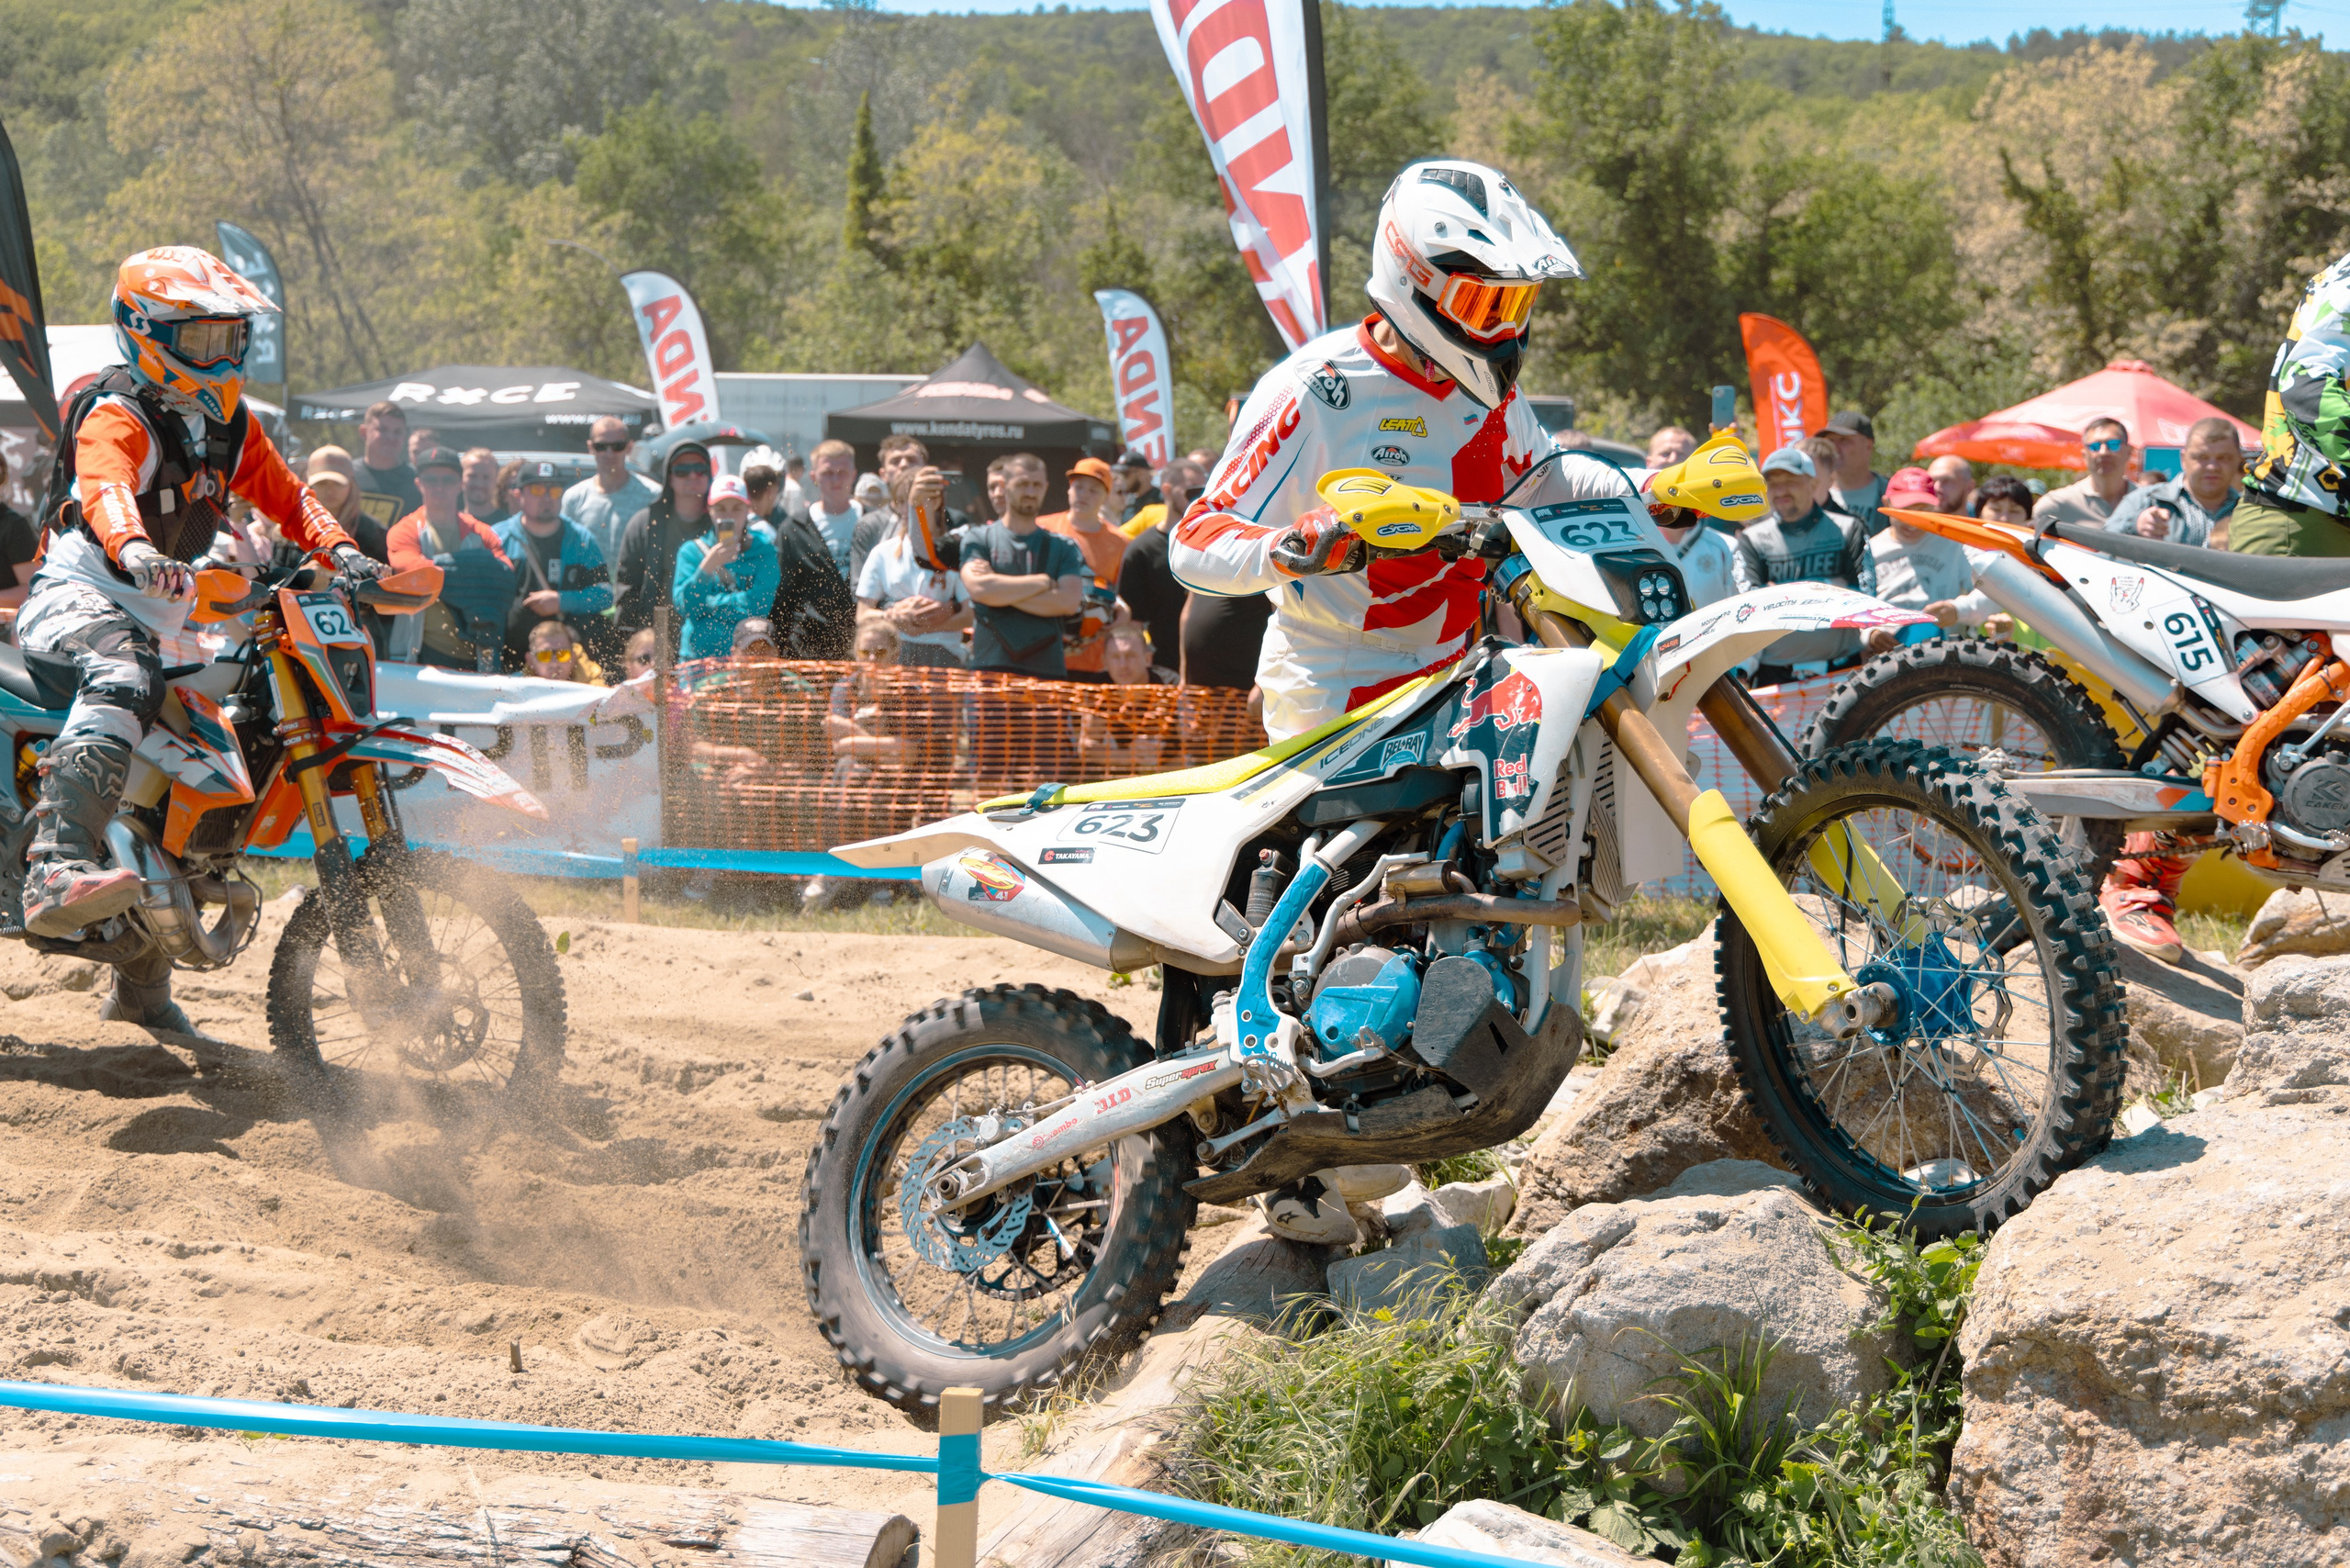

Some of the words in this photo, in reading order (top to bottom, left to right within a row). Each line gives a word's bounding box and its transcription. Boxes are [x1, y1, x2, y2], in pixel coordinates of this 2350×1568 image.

[204, 394, 223, 418] AIROH
[1212, 396, 1301, 512] ACING
[1374, 447, 1407, 462] Airoh
[1720, 495, 1763, 507] CYCRA
[1378, 523, 1421, 536] CYCRA
[1561, 521, 1645, 547] 623
[1805, 557, 1835, 577] LEE
[1763, 599, 1797, 612] VELOCITY
[2164, 612, 2214, 672] 615
[1319, 717, 1385, 769] ICEONE
[1494, 753, 1528, 778] Red
[1074, 813, 1164, 842] 623
[1055, 851, 1091, 860] TAKAYAMA
[1146, 1058, 1219, 1090] Supersprax
